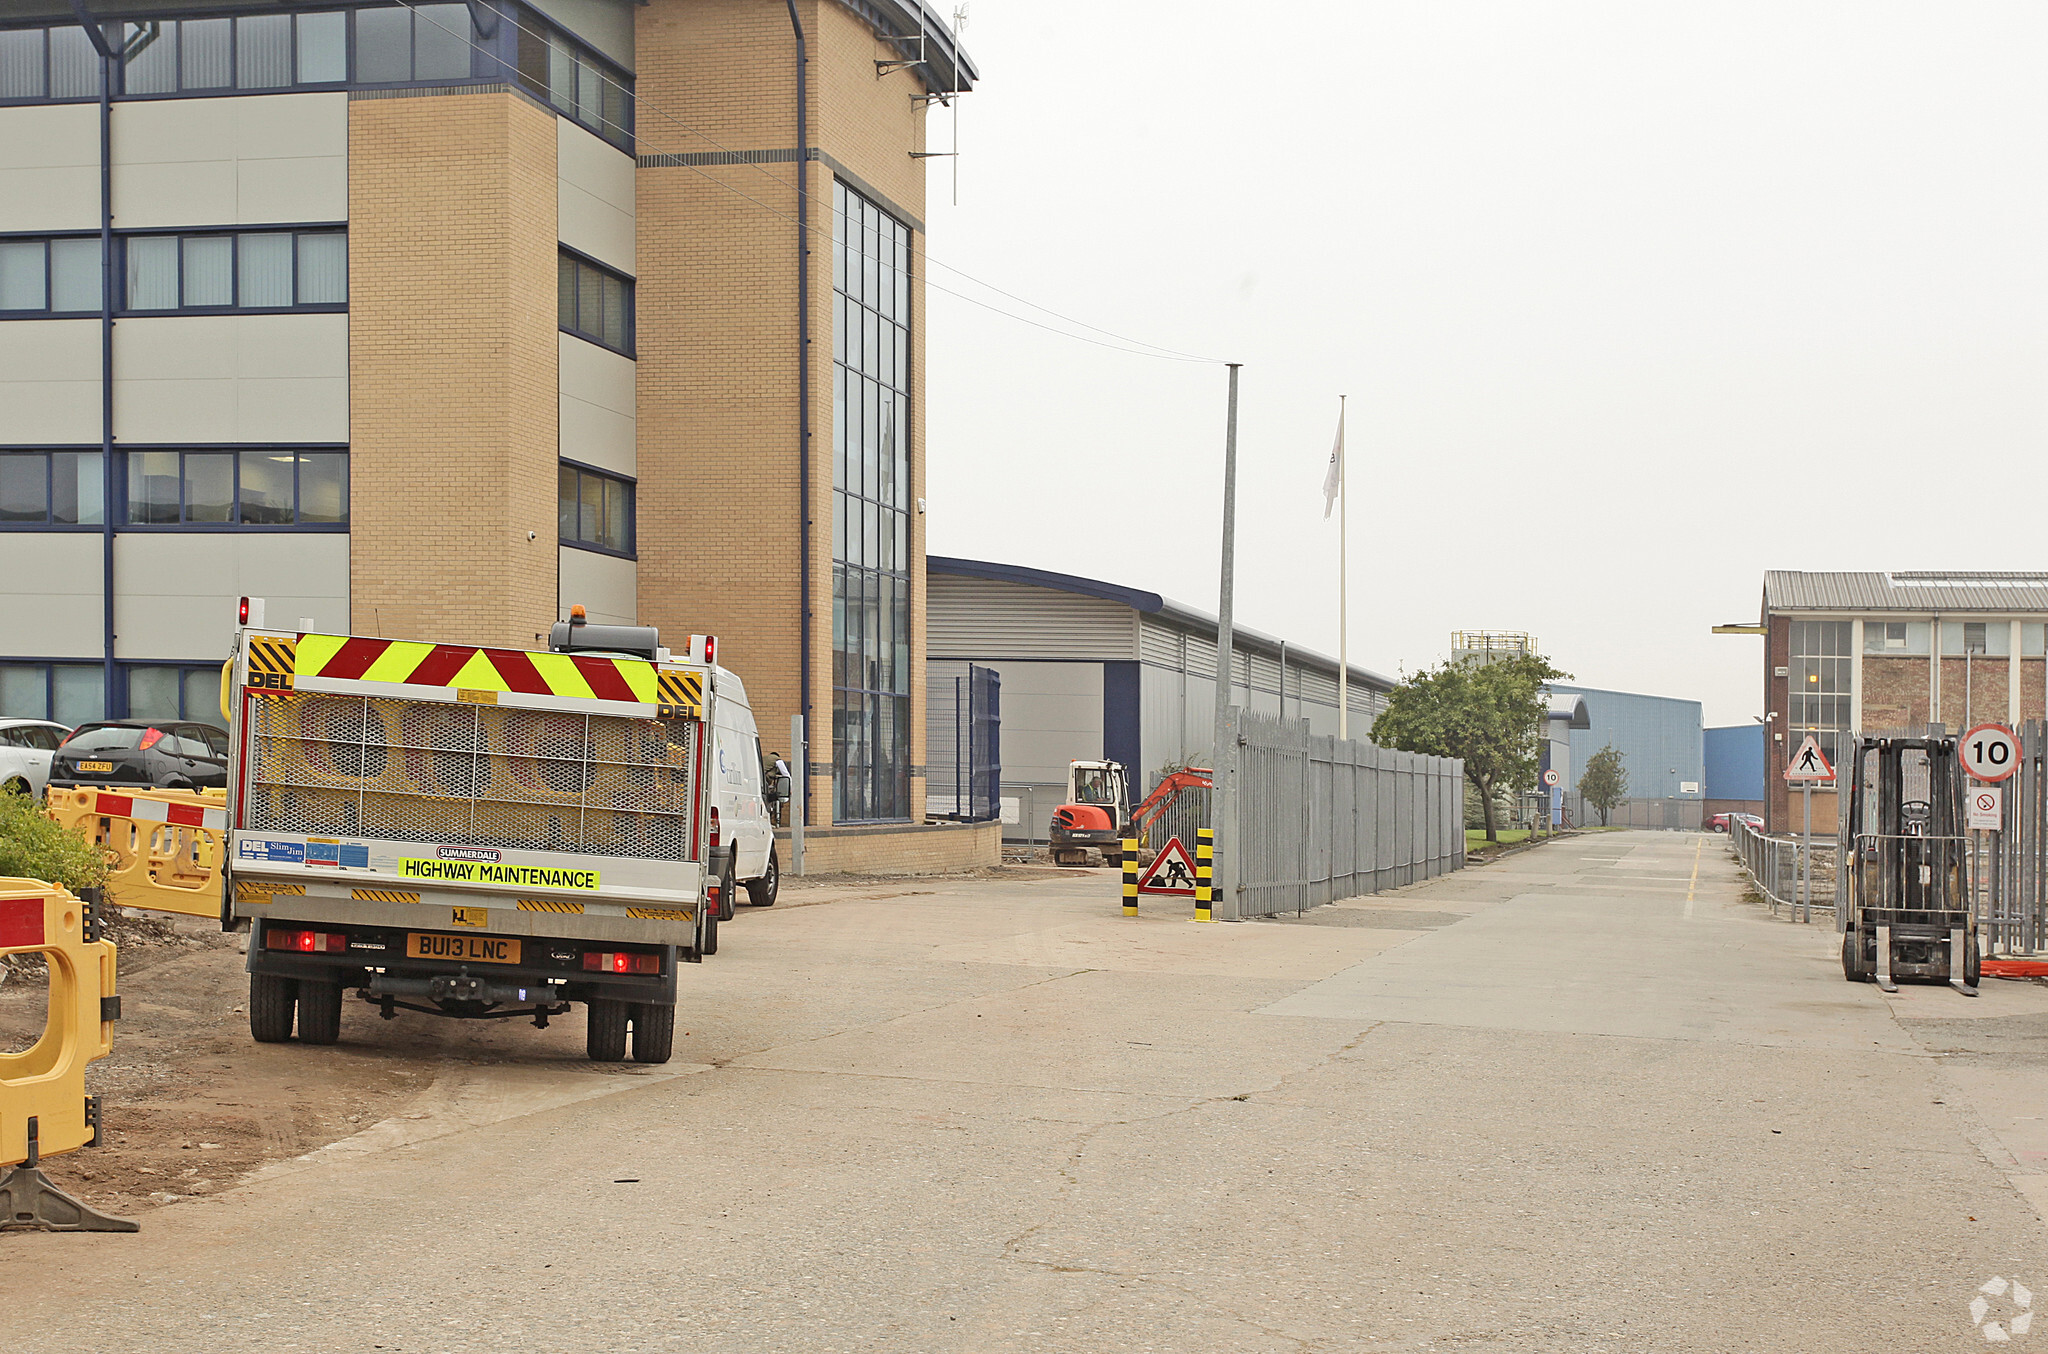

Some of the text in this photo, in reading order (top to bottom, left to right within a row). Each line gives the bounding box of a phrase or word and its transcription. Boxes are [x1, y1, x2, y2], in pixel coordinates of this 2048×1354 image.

[248, 671, 292, 689] DEL
[657, 704, 700, 719] DEL
[1973, 741, 2009, 764] 10
[242, 840, 269, 852] DEL
[270, 841, 303, 855] Slim Jim
[440, 848, 498, 860] SUMMERDALE
[406, 860, 475, 880] HIGHWAY
[480, 865, 595, 888] MAINTENANCE
[419, 936, 508, 960] BU13 LNC
